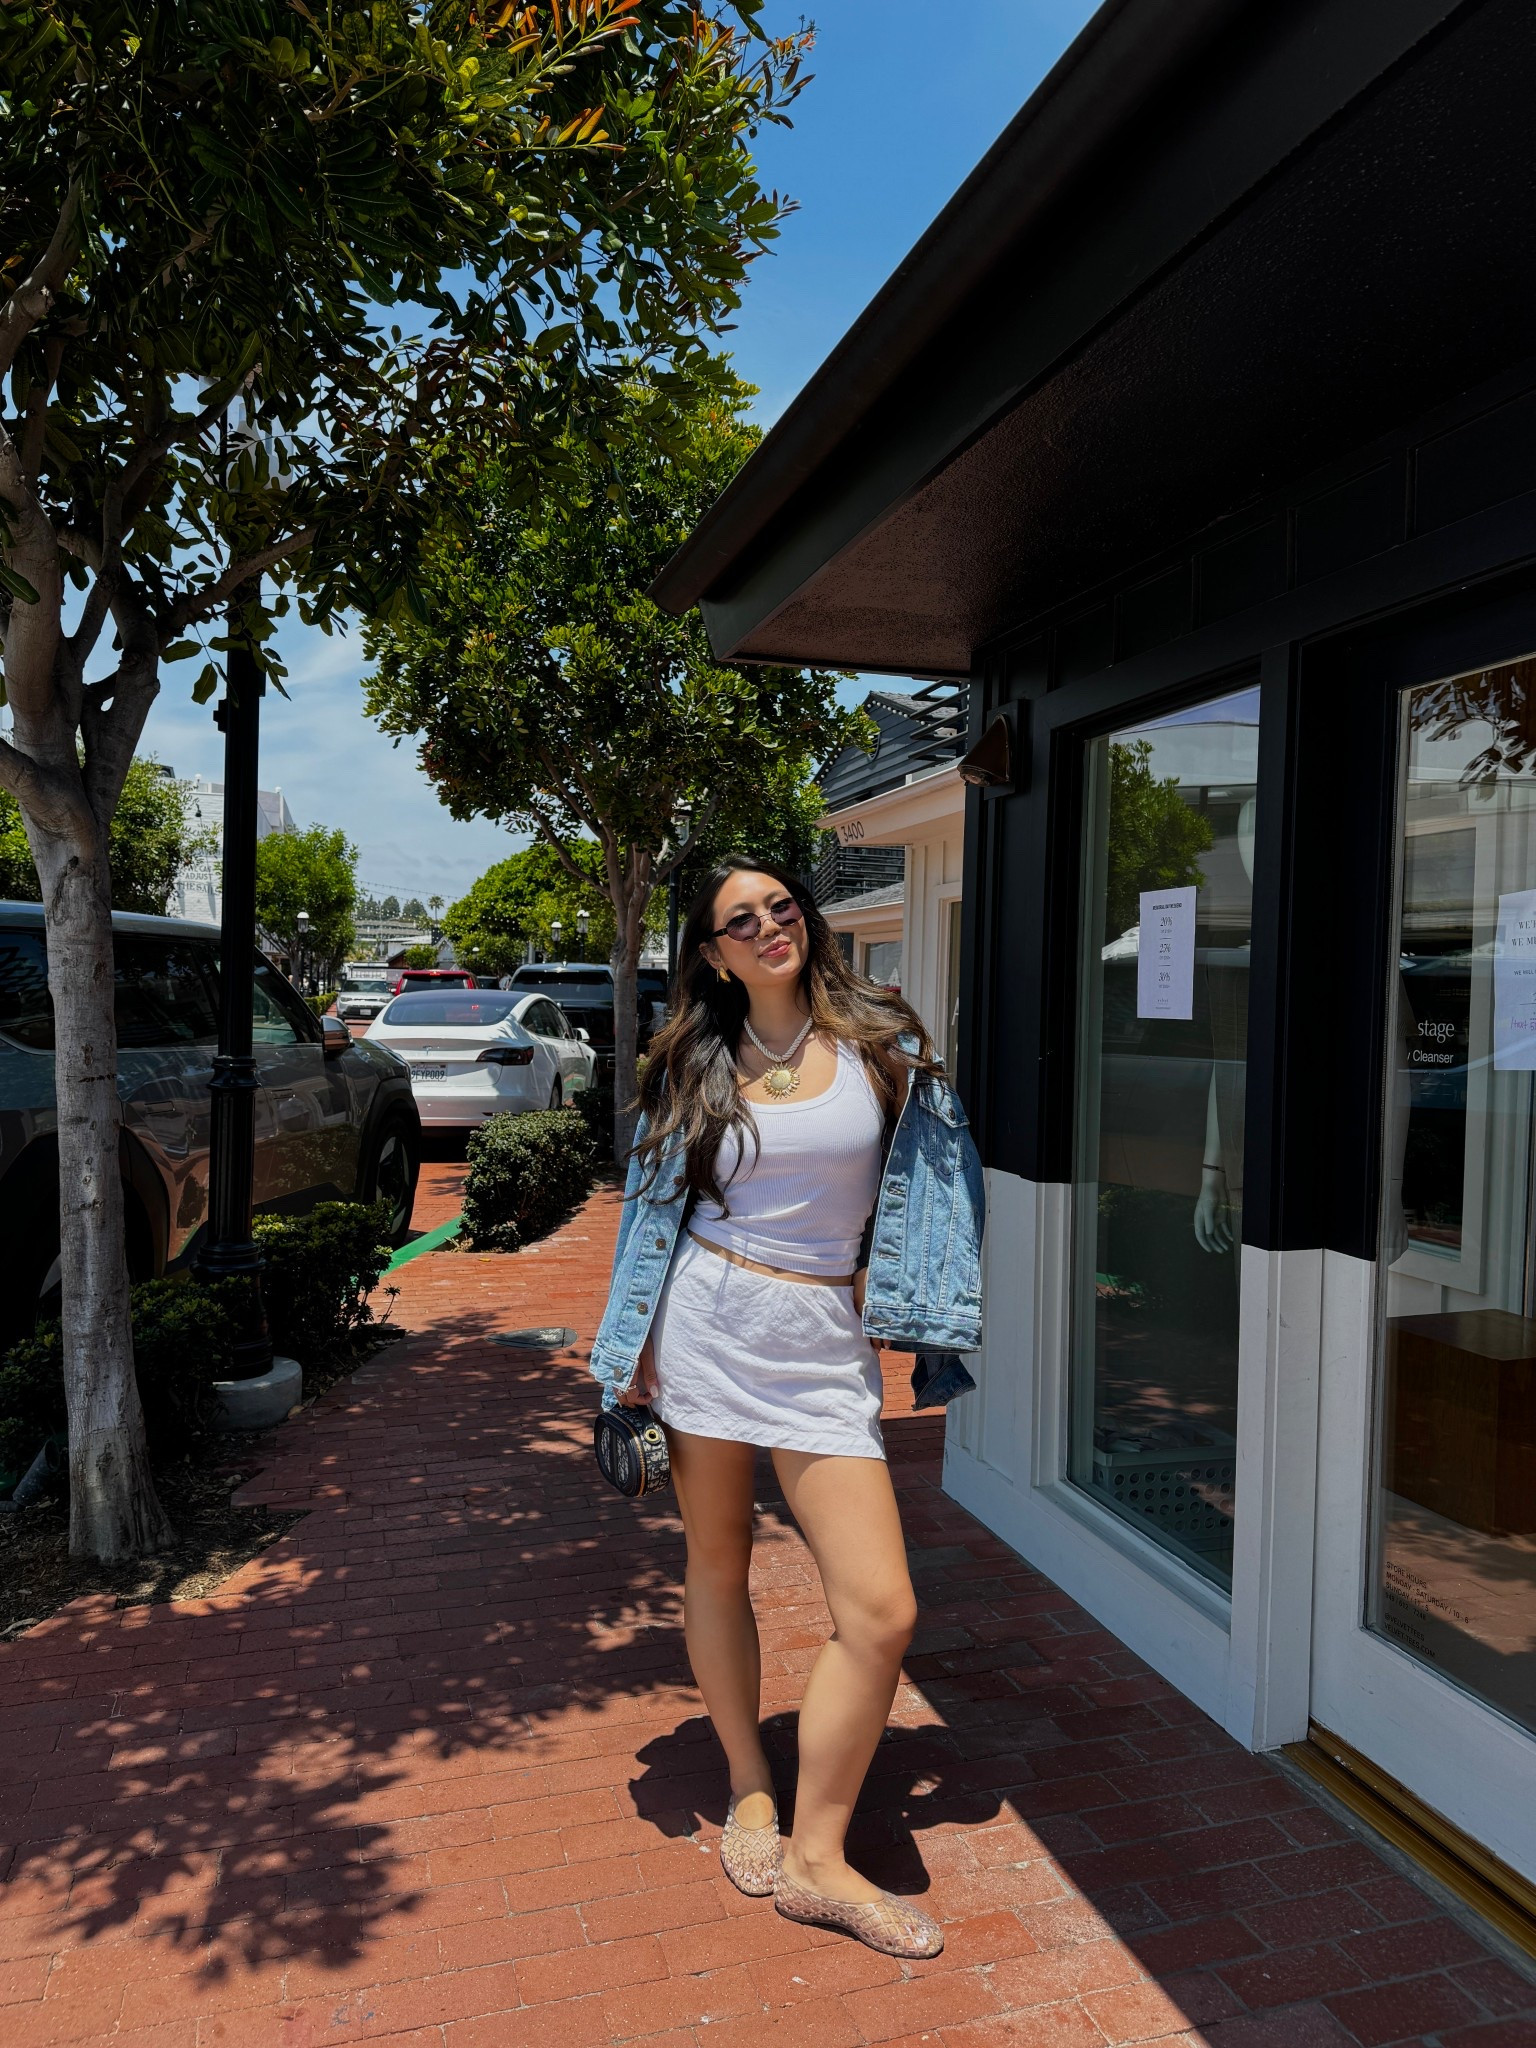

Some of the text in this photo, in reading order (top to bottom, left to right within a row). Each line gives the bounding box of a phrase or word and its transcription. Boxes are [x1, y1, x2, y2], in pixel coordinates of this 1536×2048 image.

[840, 820, 865, 842] 3400
[185, 872, 213, 881] ADJUST
[1511, 937, 1524, 946] WE
[1417, 1019, 1455, 1044] stage
[1412, 1049, 1454, 1064] Cleanser
[1386, 1561, 1427, 1589] STORE HOURS
[1385, 1581, 1410, 1601] SUNDAY
[1386, 1571, 1411, 1590] MONDAY
[1416, 1588, 1449, 1612] SATURDAY
[1453, 1610, 1460, 1619] 10
